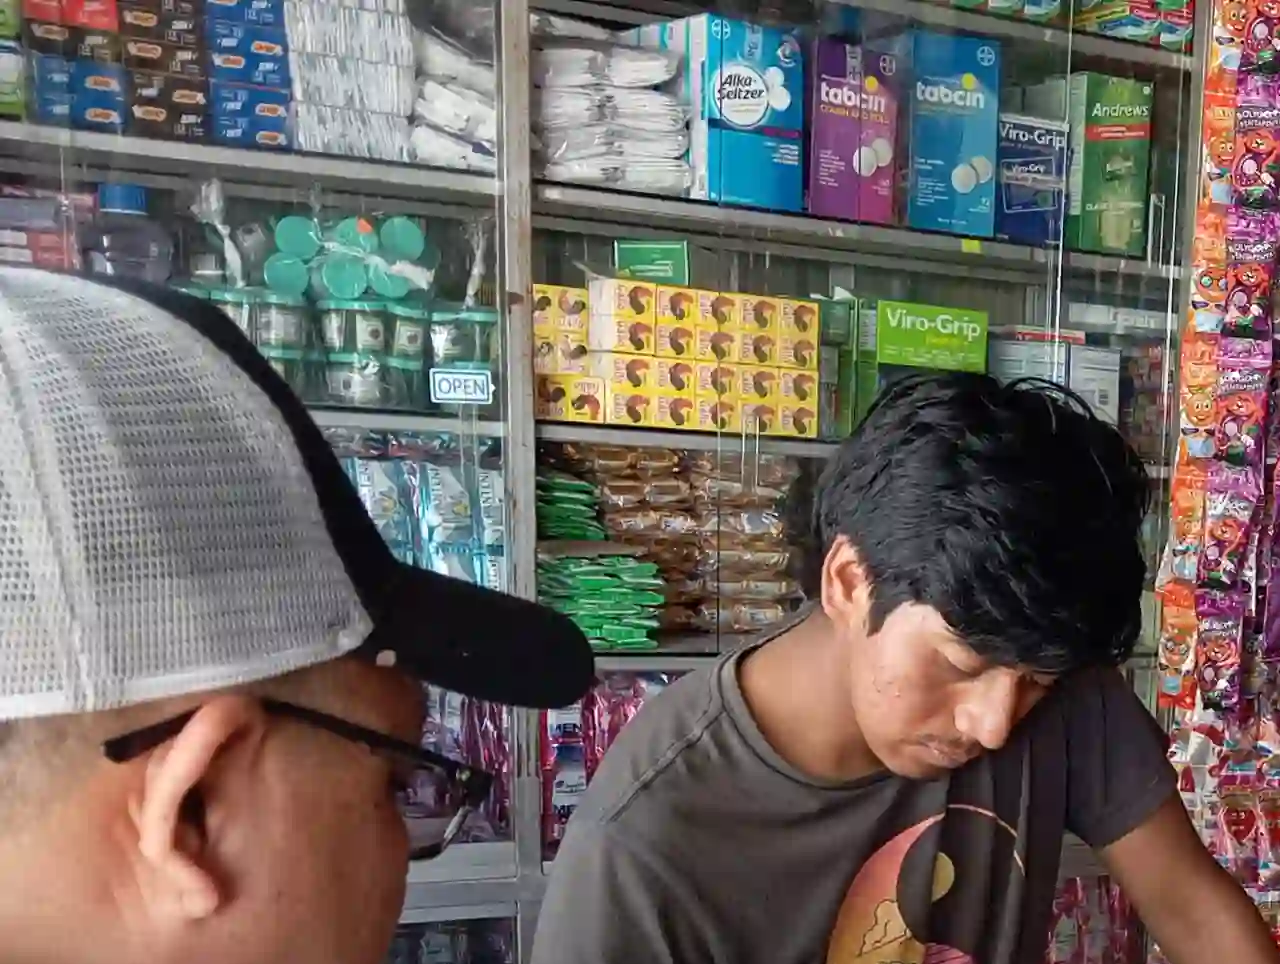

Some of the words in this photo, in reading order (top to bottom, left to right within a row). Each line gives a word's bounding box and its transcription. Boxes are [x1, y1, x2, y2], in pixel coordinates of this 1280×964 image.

[721, 73, 757, 87] Alka-
[717, 86, 765, 100] Seltzer
[820, 82, 886, 112] tabcin
[916, 81, 985, 109] tabcin
[1092, 102, 1149, 118] Andrews
[1000, 121, 1066, 151] Viro-Grip
[886, 307, 982, 340] Viro-Grip
[438, 377, 485, 396] OPEN
[553, 804, 579, 819] ME
